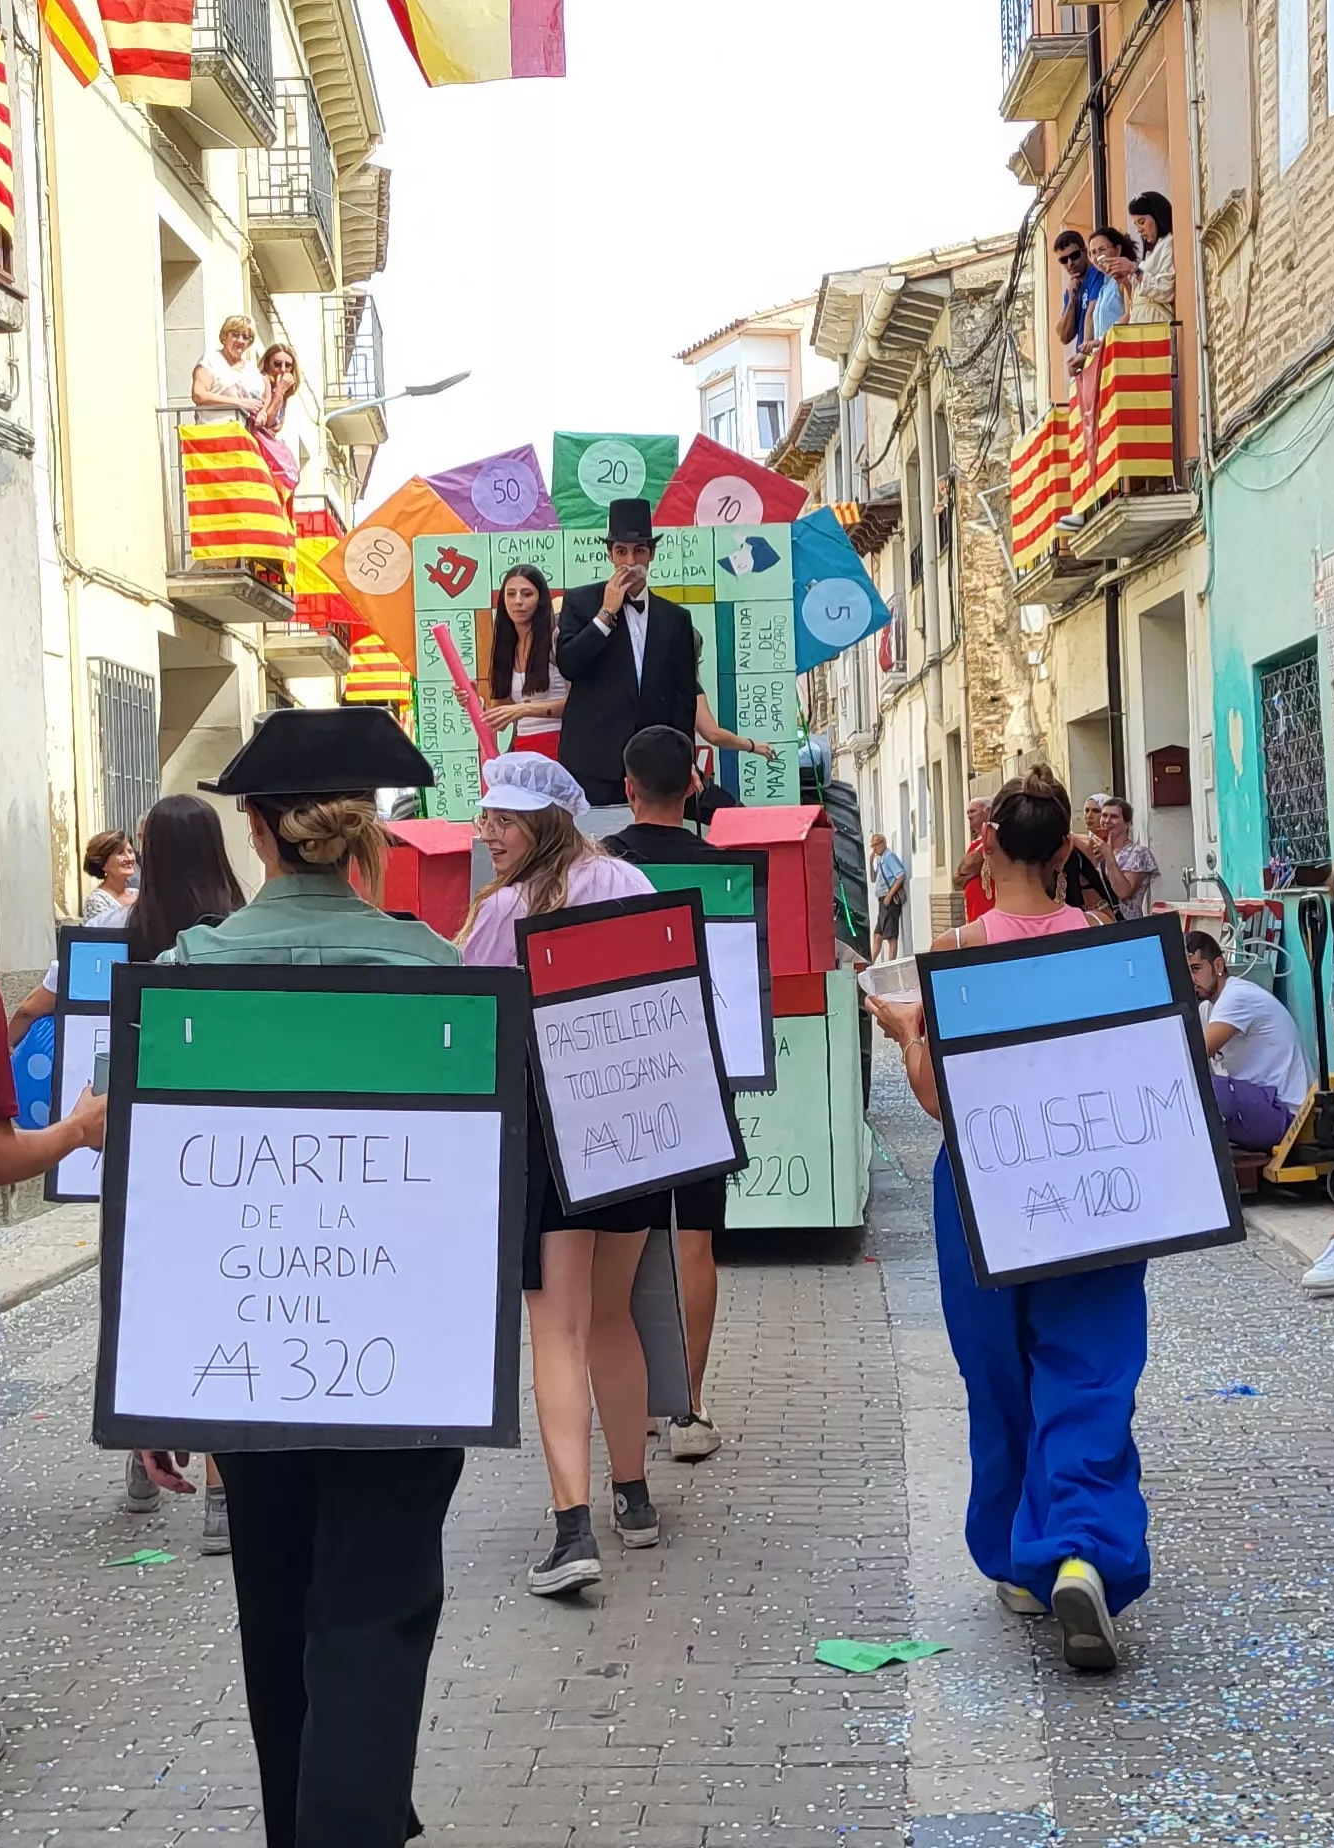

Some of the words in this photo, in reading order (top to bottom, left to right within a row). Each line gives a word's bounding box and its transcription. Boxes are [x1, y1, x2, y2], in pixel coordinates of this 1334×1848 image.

[597, 459, 629, 485] 20
[493, 478, 520, 504] 50
[717, 495, 742, 523] 10
[498, 535, 555, 554] CAMINO
[573, 535, 605, 545] AVEN
[658, 552, 674, 562] DE
[683, 549, 695, 558] LA
[359, 538, 395, 581] 500
[507, 555, 520, 565] DE
[528, 554, 546, 564] LOS
[650, 565, 707, 578] CULADA
[825, 606, 850, 621] 5
[455, 611, 474, 666] CAMINO
[740, 608, 752, 669] AVENIDA
[758, 620, 772, 650] DEL
[773, 614, 787, 670] ROSARIO
[442, 690, 454, 708] DE
[739, 683, 751, 728] CALLE
[753, 684, 767, 728] PEDRO
[771, 680, 784, 732] SAPUTO
[423, 687, 439, 750] DEPORTES
[442, 713, 456, 735] LOS
[452, 763, 462, 777] DE
[465, 755, 481, 807] FUENTE
[744, 759, 757, 797] PLAZA
[767, 749, 786, 799] MAYOR
[545, 989, 689, 1059] PASTELERÍA
[564, 1051, 687, 1101] TOLOSANA
[965, 1078, 1195, 1173] COLISEUM
[179, 1134, 432, 1188] CUARTEL
[241, 1203, 285, 1230] DE
[319, 1203, 356, 1229] LA
[219, 1244, 397, 1280] GUARDIA
[237, 1294, 331, 1324] CIVIL
